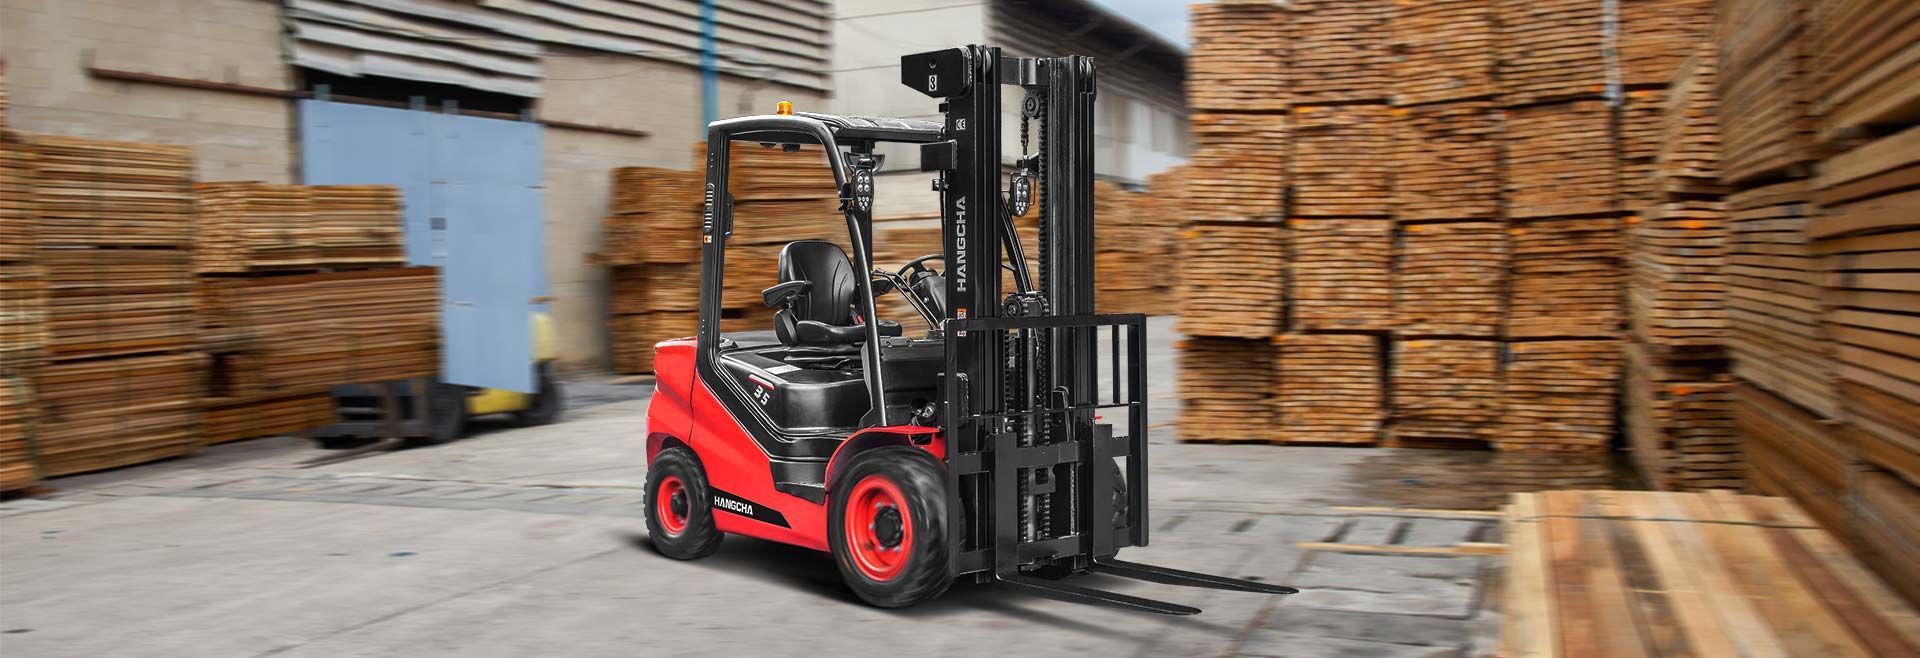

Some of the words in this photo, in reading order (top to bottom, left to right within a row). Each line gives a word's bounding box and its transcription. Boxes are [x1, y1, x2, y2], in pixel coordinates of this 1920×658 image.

[956, 196, 967, 292] HANGCHA
[753, 384, 770, 406] 35
[714, 495, 753, 516] HANGCHA
